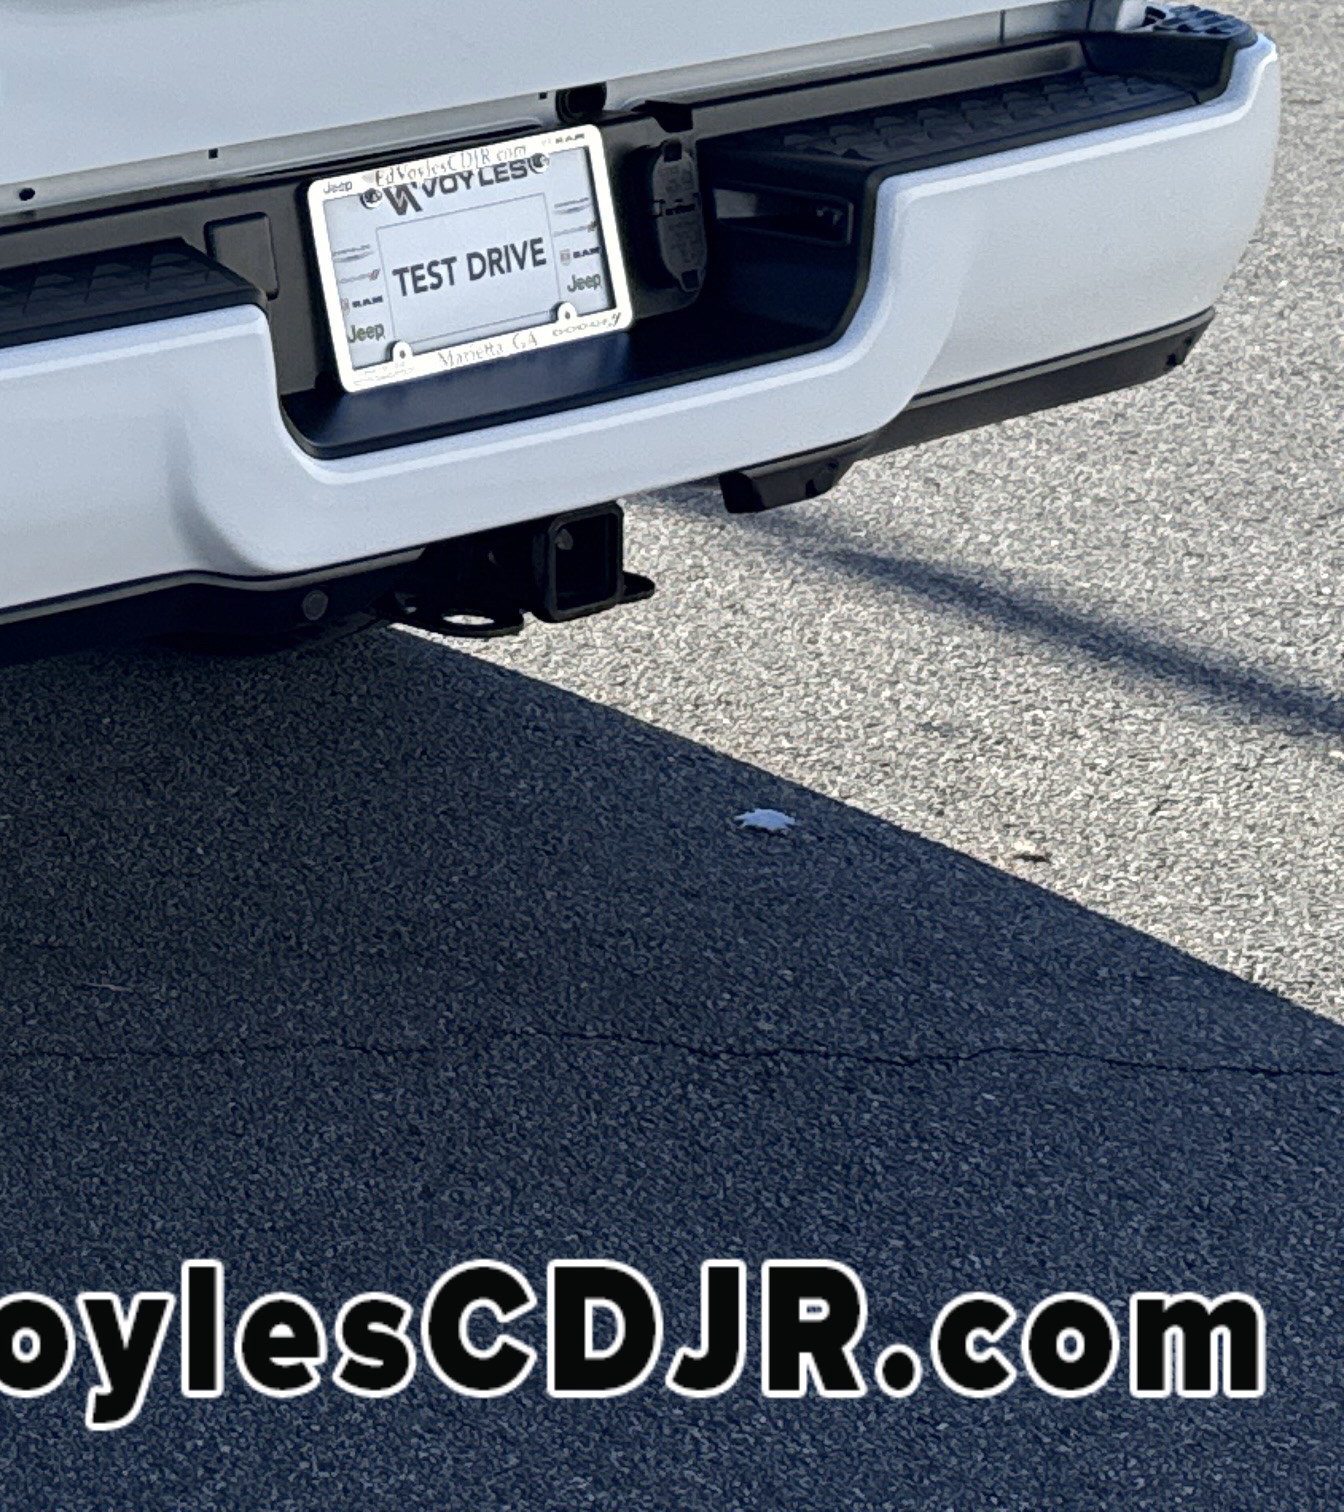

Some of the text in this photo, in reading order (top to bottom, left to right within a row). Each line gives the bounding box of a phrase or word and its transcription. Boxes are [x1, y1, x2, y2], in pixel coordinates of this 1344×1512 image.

[421, 158, 529, 199] VOYLES
[392, 237, 547, 297] TEST DRIVE
[567, 273, 602, 293] Jeep
[352, 295, 384, 308] RAM
[347, 323, 385, 343] Jeep
